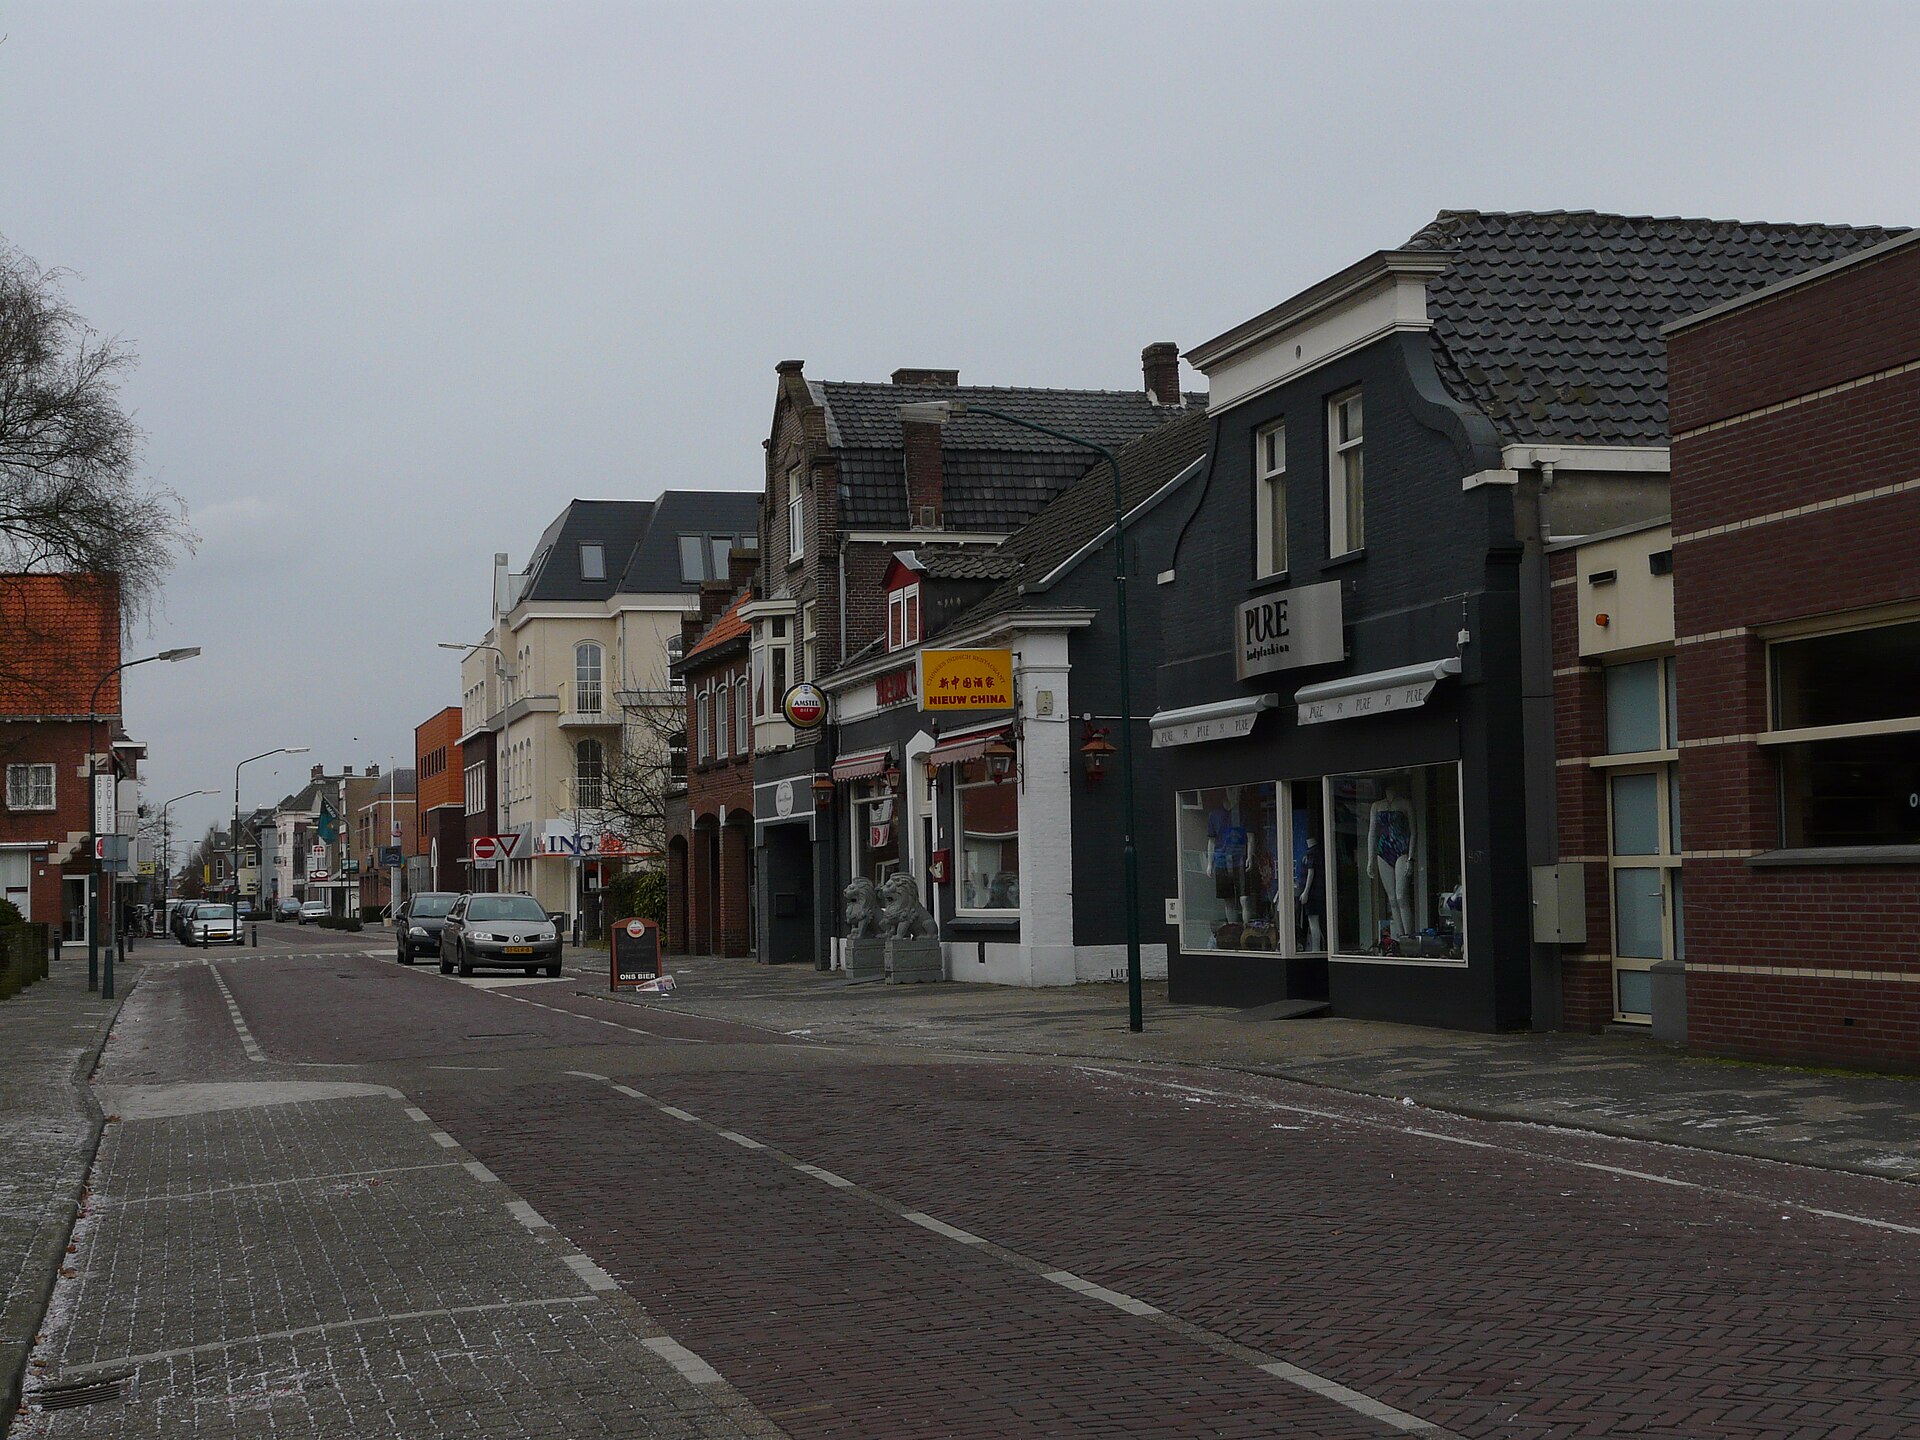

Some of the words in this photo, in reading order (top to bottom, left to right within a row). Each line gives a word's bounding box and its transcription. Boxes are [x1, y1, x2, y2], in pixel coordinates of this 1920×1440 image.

[1244, 599, 1290, 645] PURE
[1246, 643, 1290, 661] bodyfashion
[972, 655, 1006, 684] RESTAURANT
[929, 695, 967, 705] NIEUW
[970, 694, 1007, 704] CHINA
[1309, 705, 1324, 719] PURE
[1355, 697, 1372, 711] PURE
[1405, 688, 1423, 703] PURE
[1235, 718, 1249, 732] PURE
[549, 835, 594, 852] ING
